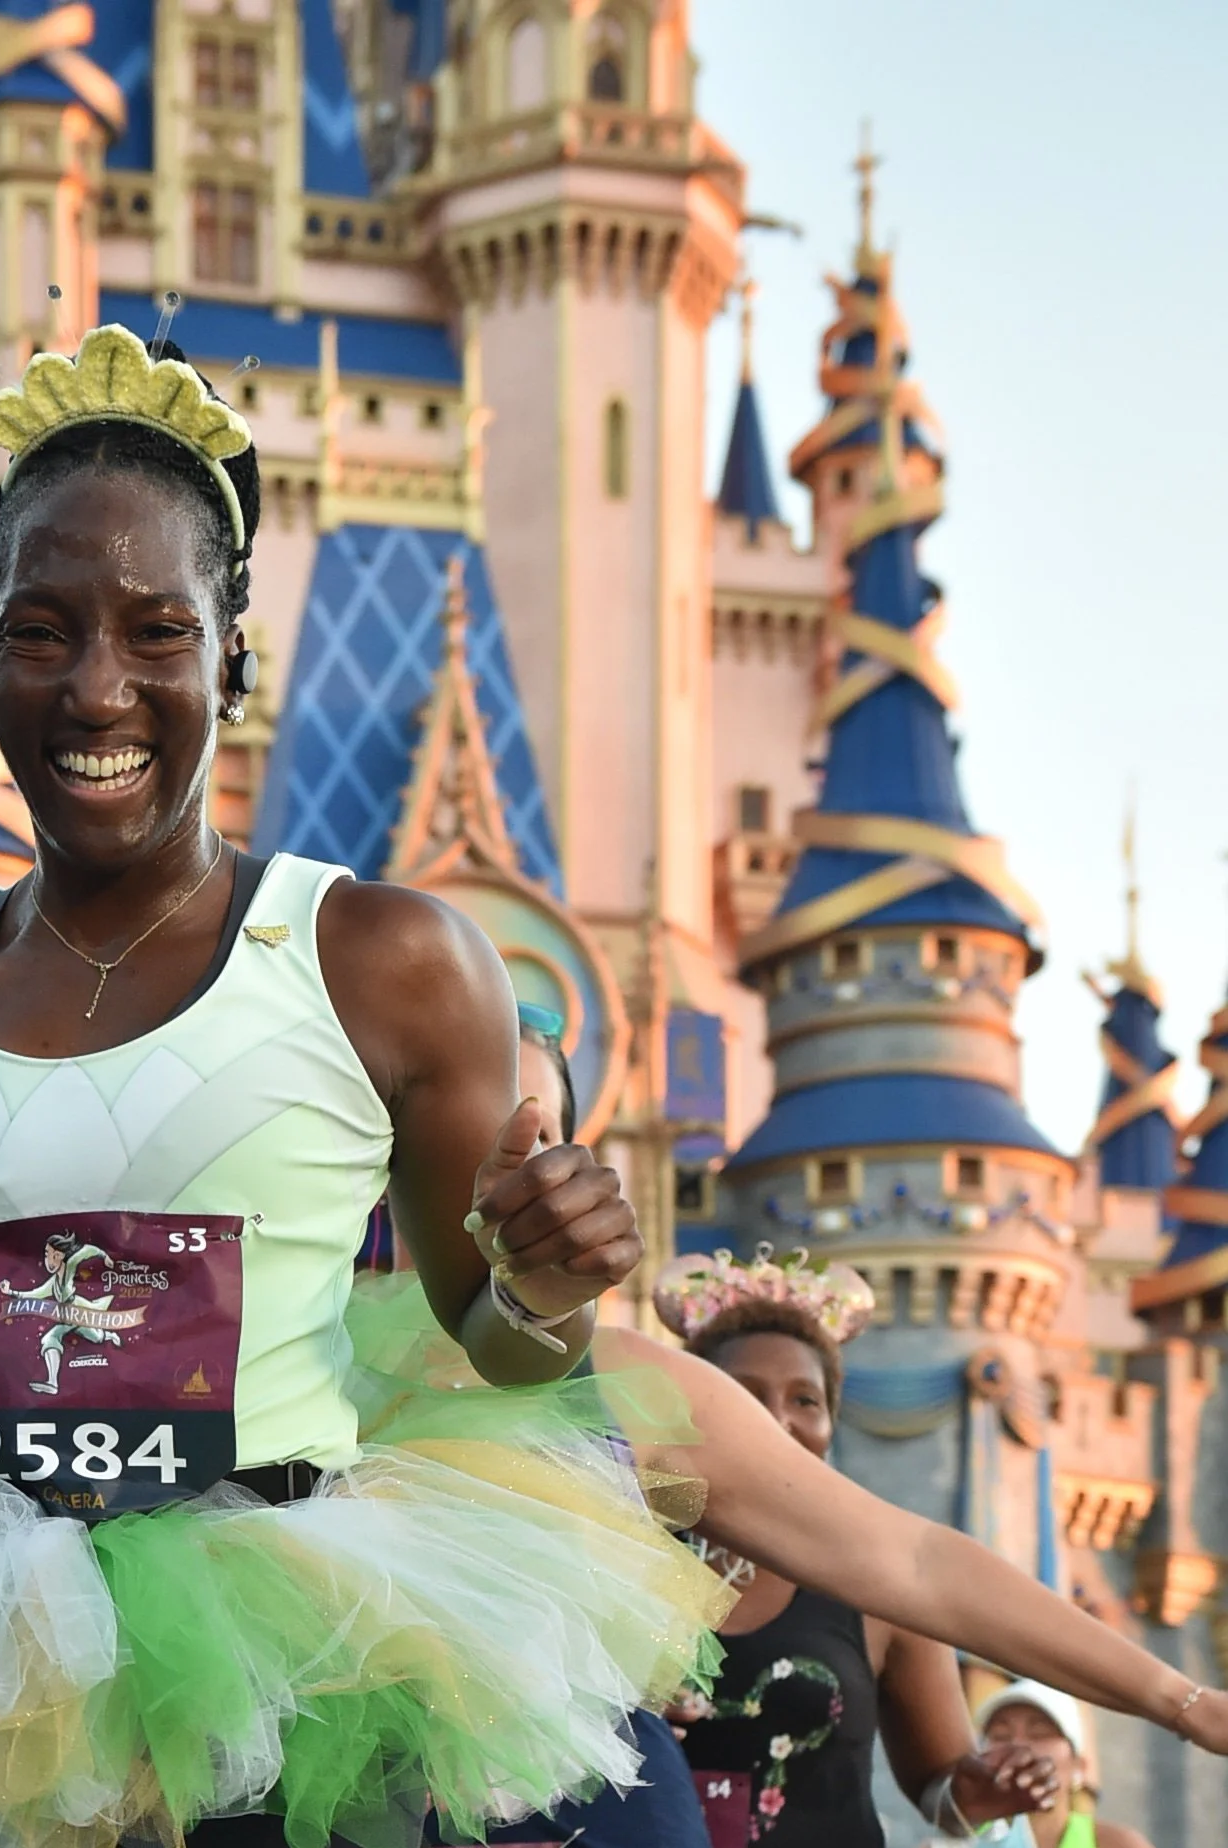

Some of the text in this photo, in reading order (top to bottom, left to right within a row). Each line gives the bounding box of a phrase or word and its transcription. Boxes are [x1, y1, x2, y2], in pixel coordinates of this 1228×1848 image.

[116, 1260, 150, 1274] Disney
[118, 1287, 152, 1299] 2022
[7, 1300, 49, 1314] HALF
